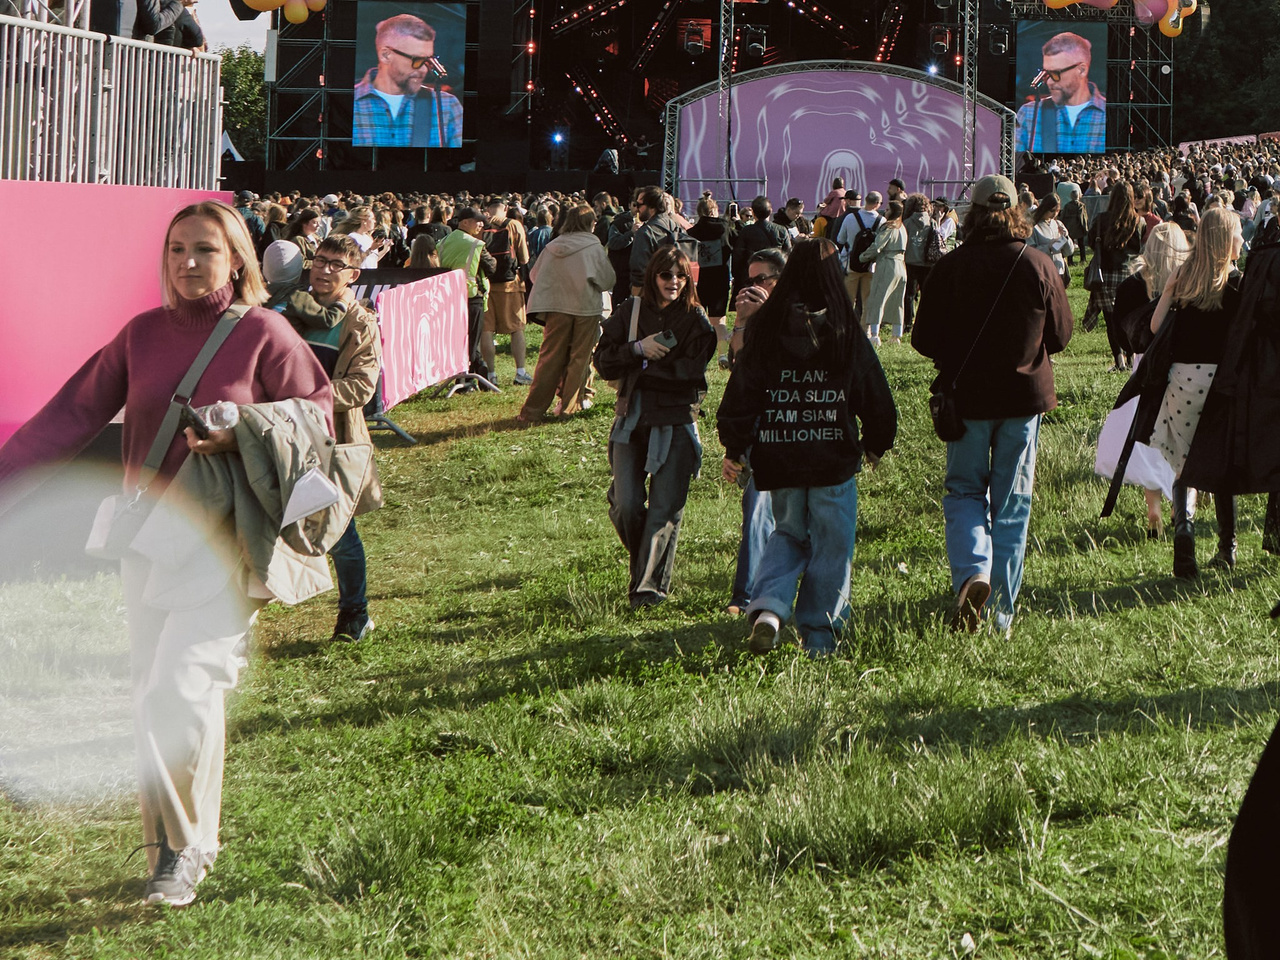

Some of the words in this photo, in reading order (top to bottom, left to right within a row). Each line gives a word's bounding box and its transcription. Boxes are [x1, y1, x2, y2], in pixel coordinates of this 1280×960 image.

[780, 370, 828, 382] PLAN:
[766, 389, 801, 403] YDA
[805, 389, 846, 403] SUDA
[766, 409, 798, 423] TAM
[802, 409, 837, 422] SIAM
[759, 428, 844, 443] MILLIONER
